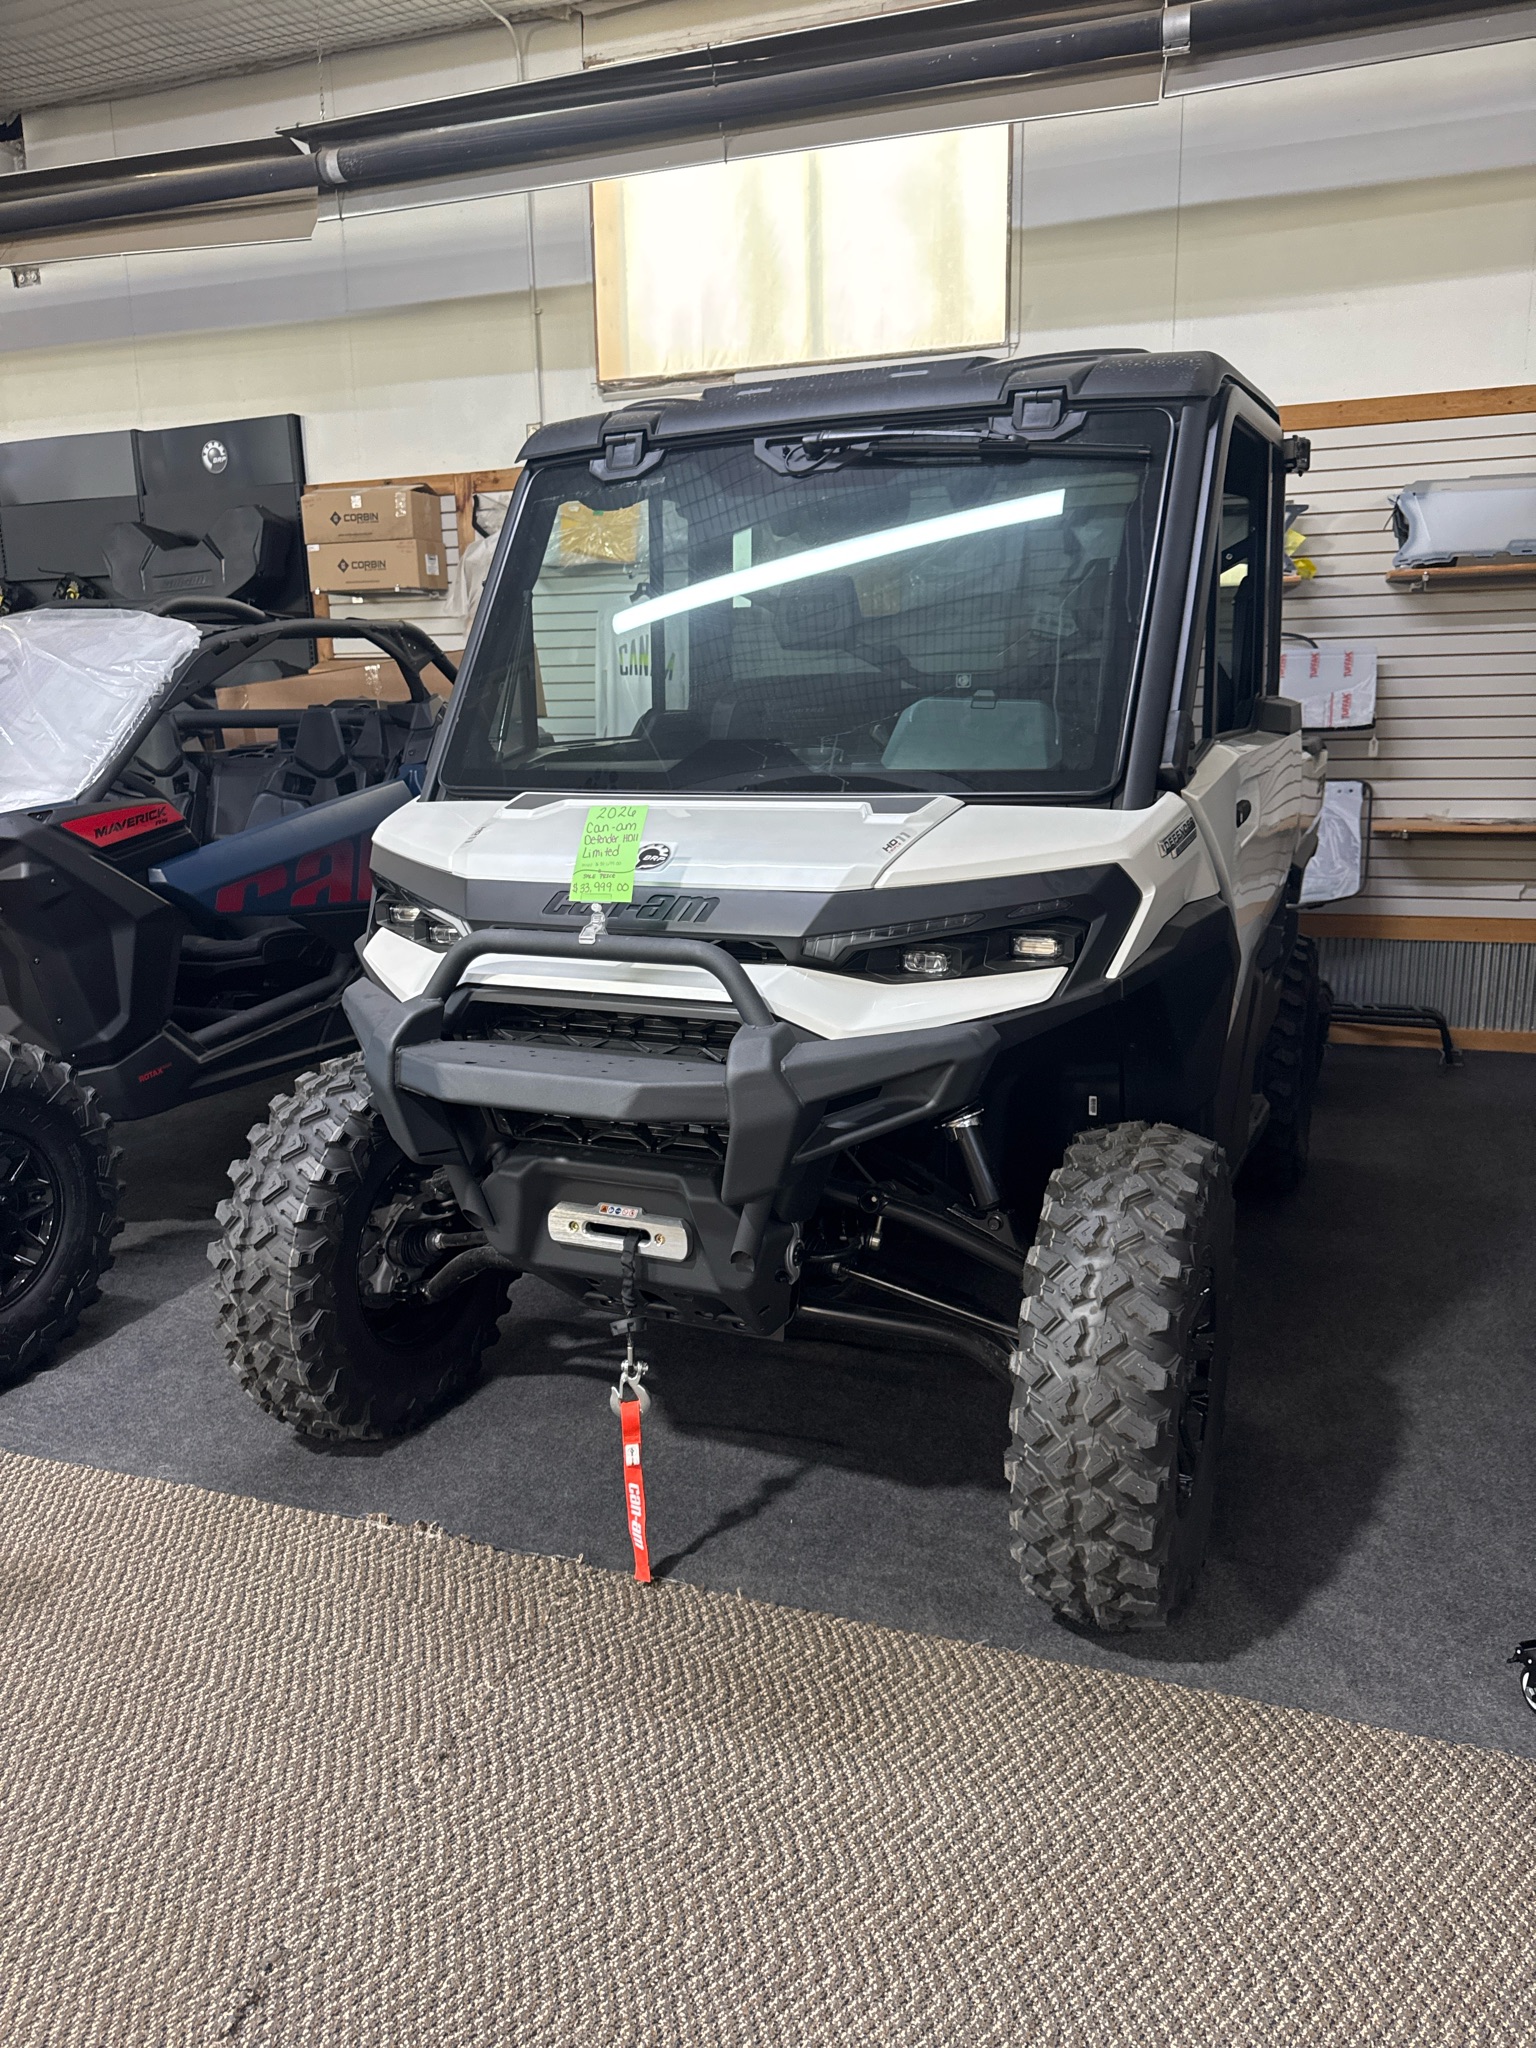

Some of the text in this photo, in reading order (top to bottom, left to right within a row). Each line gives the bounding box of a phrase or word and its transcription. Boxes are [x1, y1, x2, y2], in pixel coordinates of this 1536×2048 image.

[343, 512, 379, 523] CORBIN
[351, 560, 386, 571] CORBIN
[1309, 652, 1319, 678] TUFFAK
[1343, 650, 1353, 678] TUFFAK
[1341, 692, 1352, 719] TUFFAK
[94, 806, 167, 839] MAVERICK
[596, 806, 637, 820] 2026
[584, 833, 619, 846] Defender
[582, 844, 620, 859] Limited
[642, 854, 666, 862] BRP
[542, 890, 721, 923] ca-am
[628, 1482, 645, 1551] can-am
